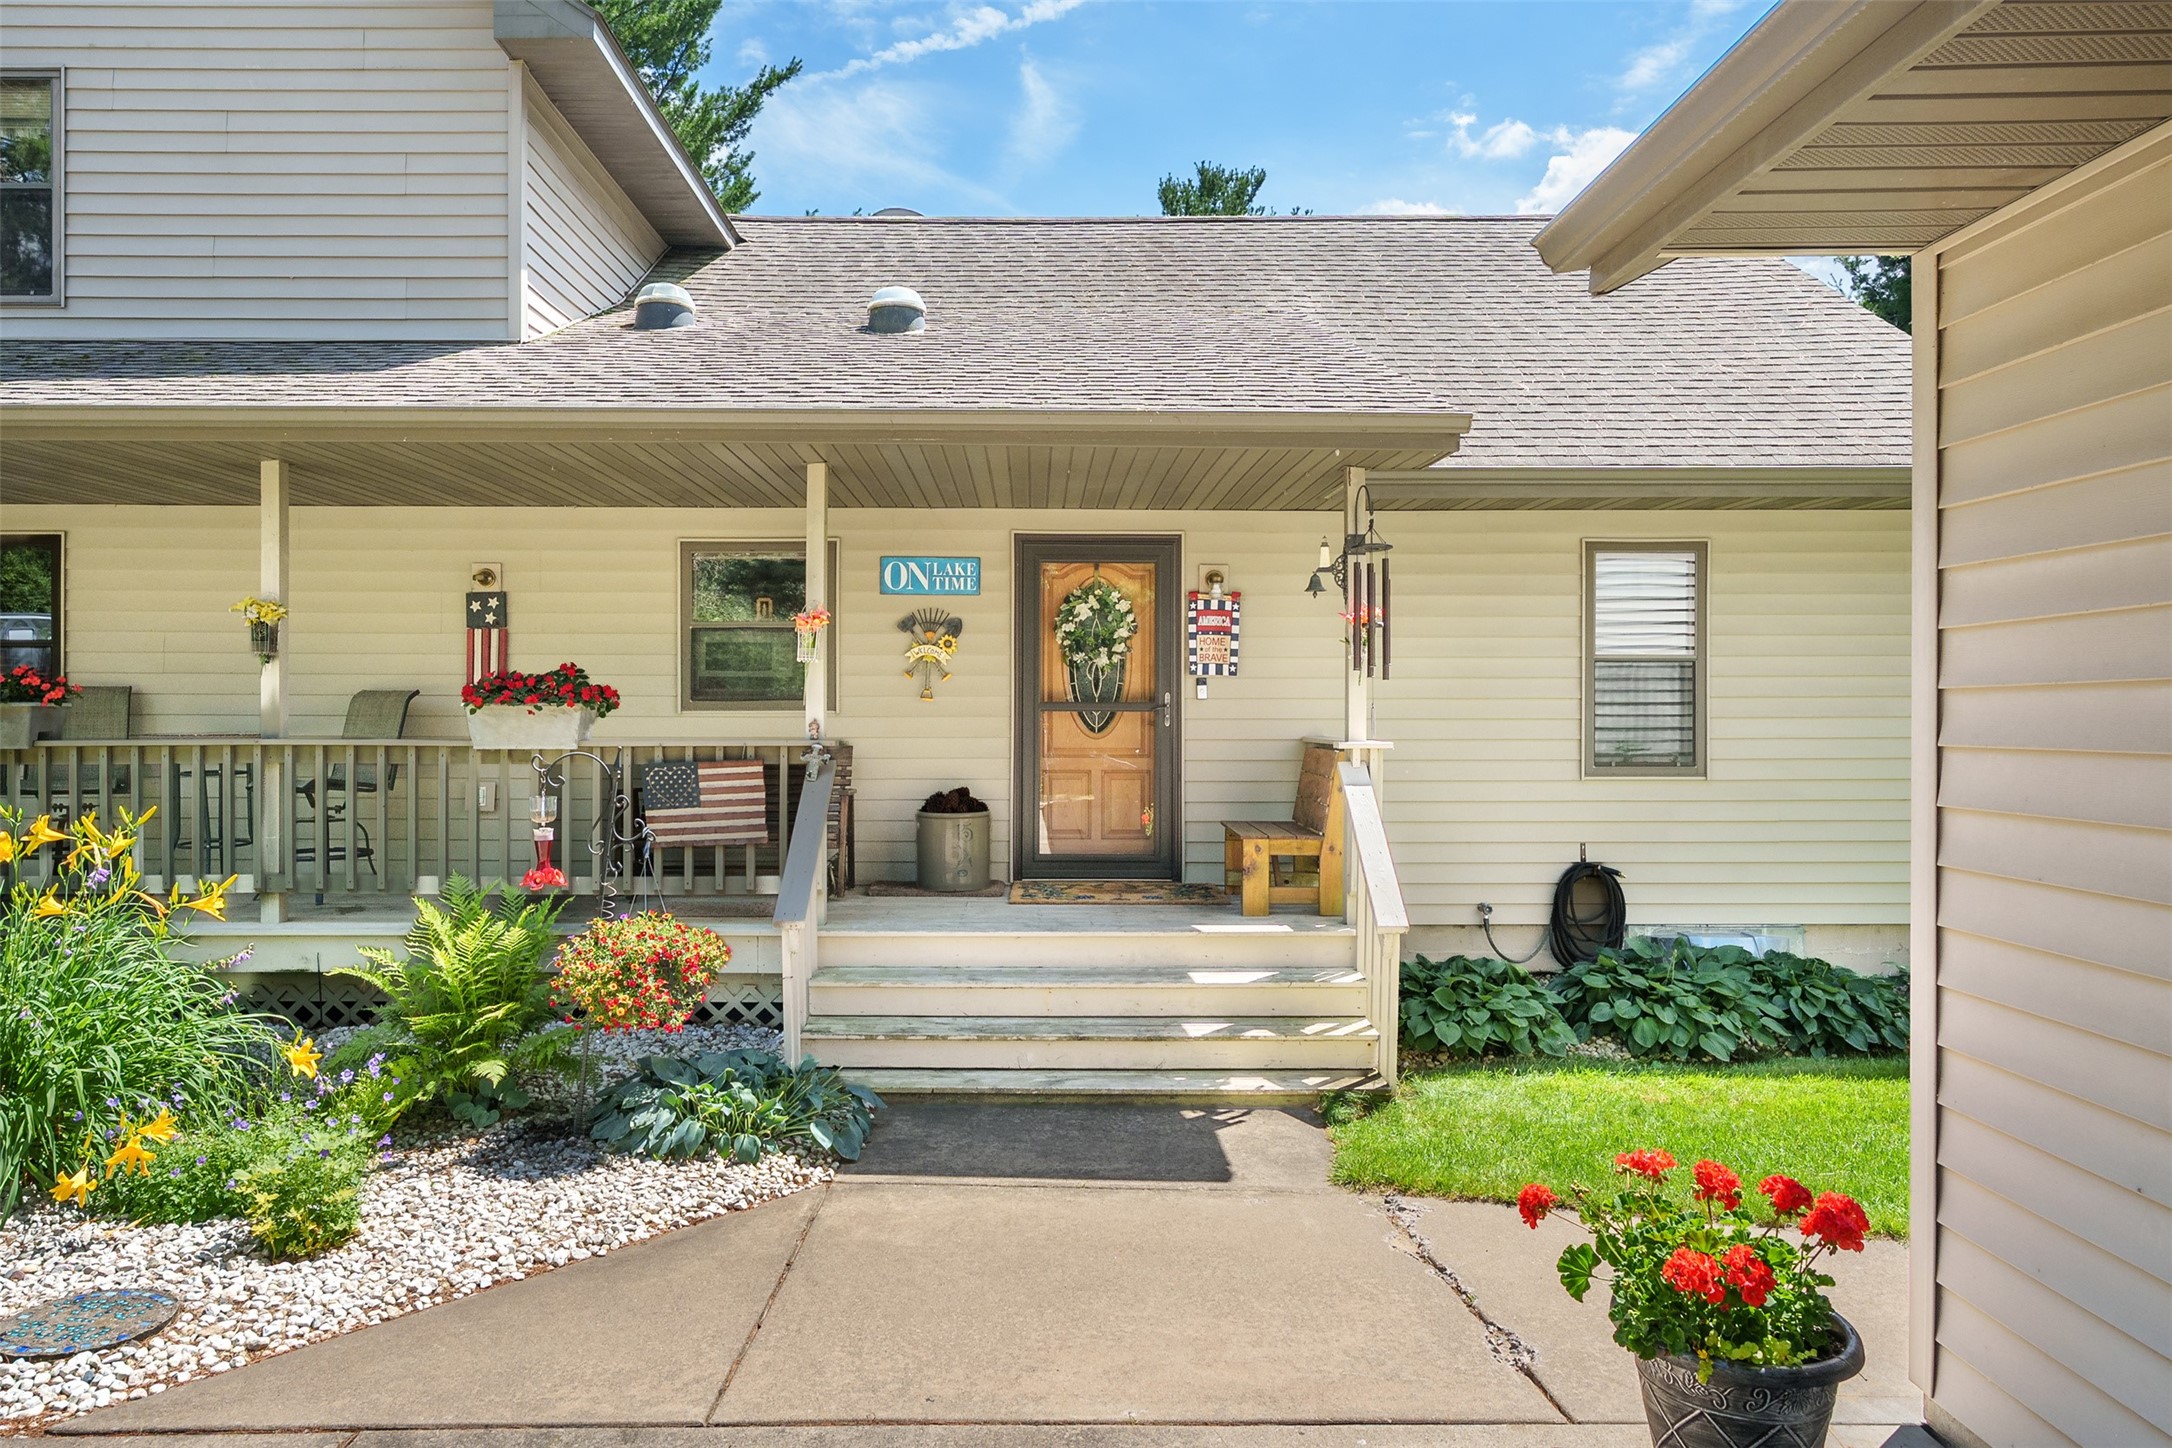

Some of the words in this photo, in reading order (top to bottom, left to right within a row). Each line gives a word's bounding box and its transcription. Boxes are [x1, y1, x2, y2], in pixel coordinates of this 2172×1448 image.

[933, 562, 977, 576] LAKE
[884, 561, 931, 590] ON
[932, 576, 977, 591] TIME
[1198, 616, 1231, 626] AMERICA
[1199, 636, 1226, 646] HOME
[911, 647, 944, 658] WELCOME
[1199, 653, 1229, 663] BRAVE
